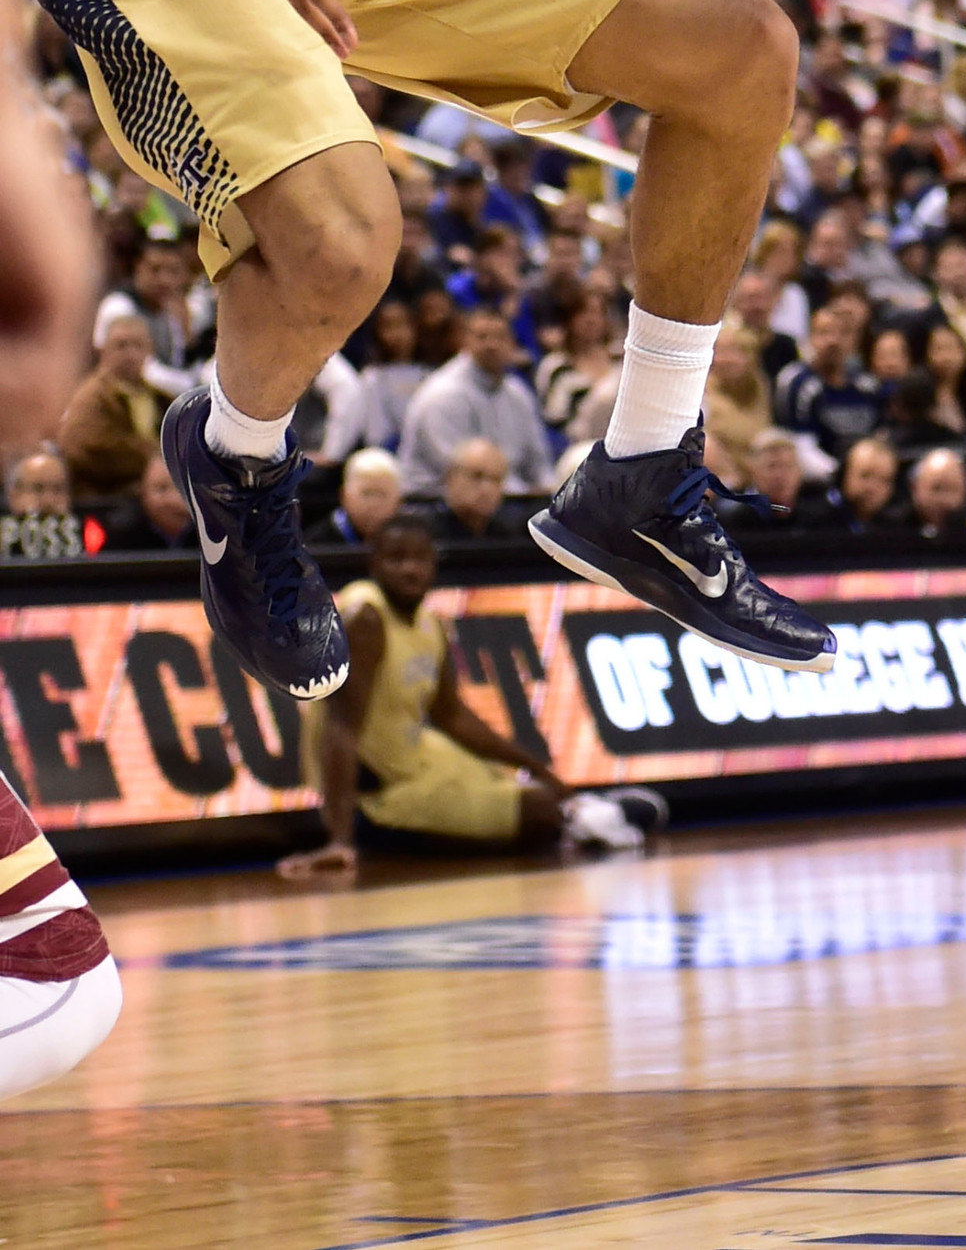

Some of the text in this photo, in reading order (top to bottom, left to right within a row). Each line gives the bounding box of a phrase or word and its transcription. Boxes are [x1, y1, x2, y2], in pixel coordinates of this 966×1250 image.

[0, 516, 82, 560] POSS
[587, 633, 674, 731] OF
[678, 619, 953, 725] COLLEGE
